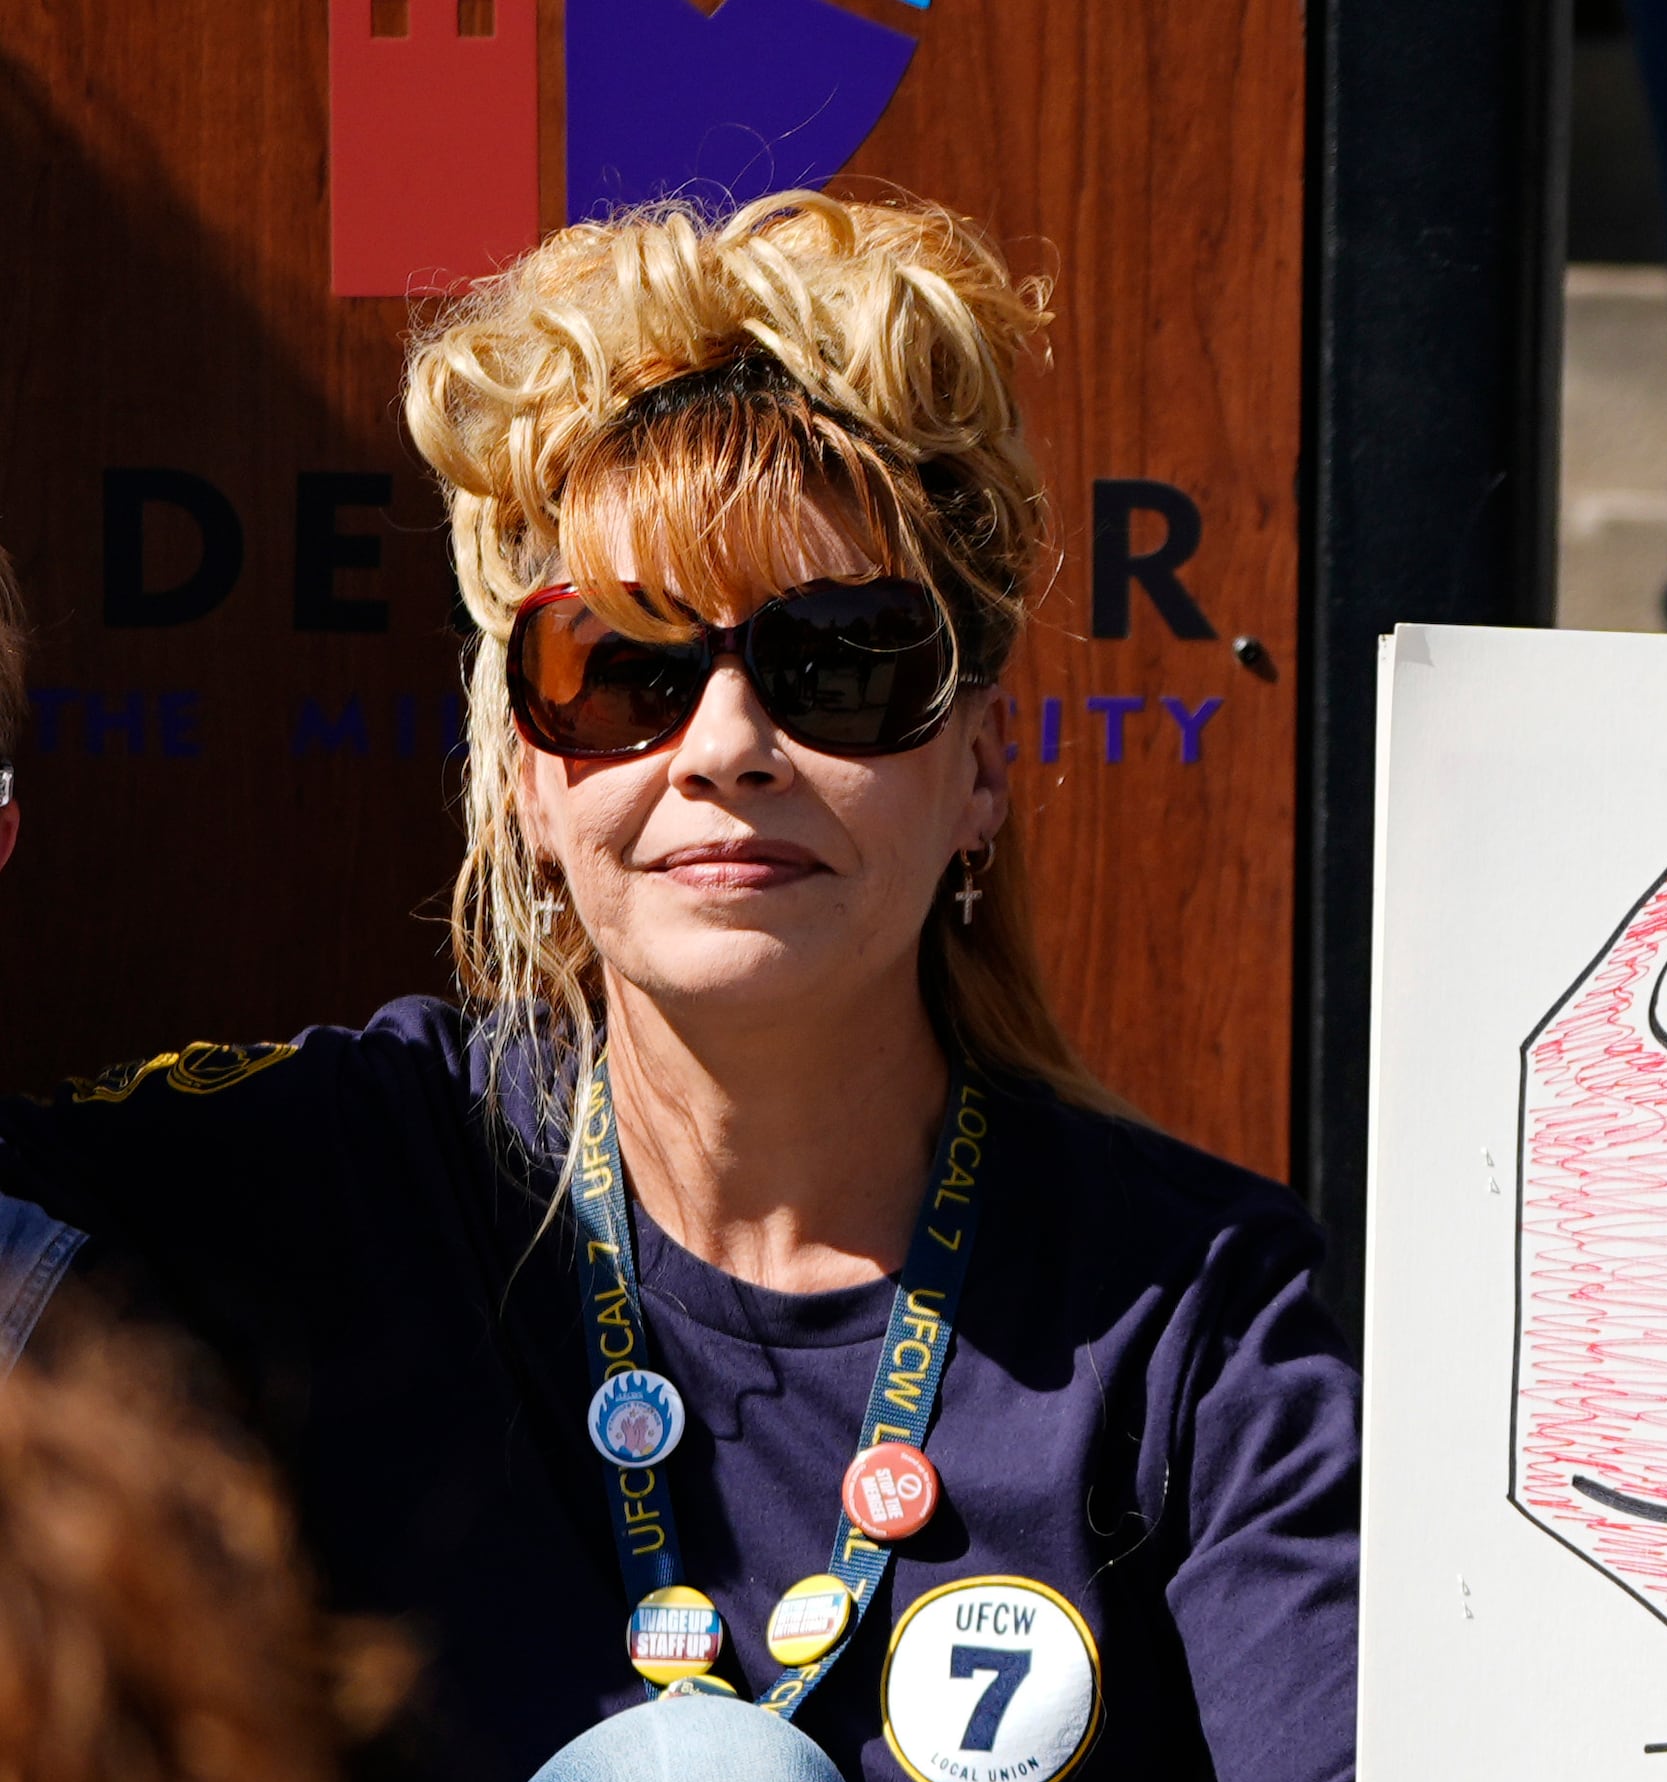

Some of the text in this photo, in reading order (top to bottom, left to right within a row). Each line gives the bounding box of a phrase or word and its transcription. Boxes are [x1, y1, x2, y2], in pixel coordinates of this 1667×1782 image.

[103, 466, 1218, 640] DER
[26, 686, 1225, 764] THE MIL ITY
[583, 1079, 614, 1200] UFCW
[927, 1085, 988, 1251] LOCAL 7
[884, 1288, 946, 1413] UFCW
[619, 1465, 665, 1555] UFC
[955, 1602, 1036, 1636] UFCW
[950, 1643, 1032, 1753] 7
[930, 1752, 1040, 1782] LOCAL UNION
